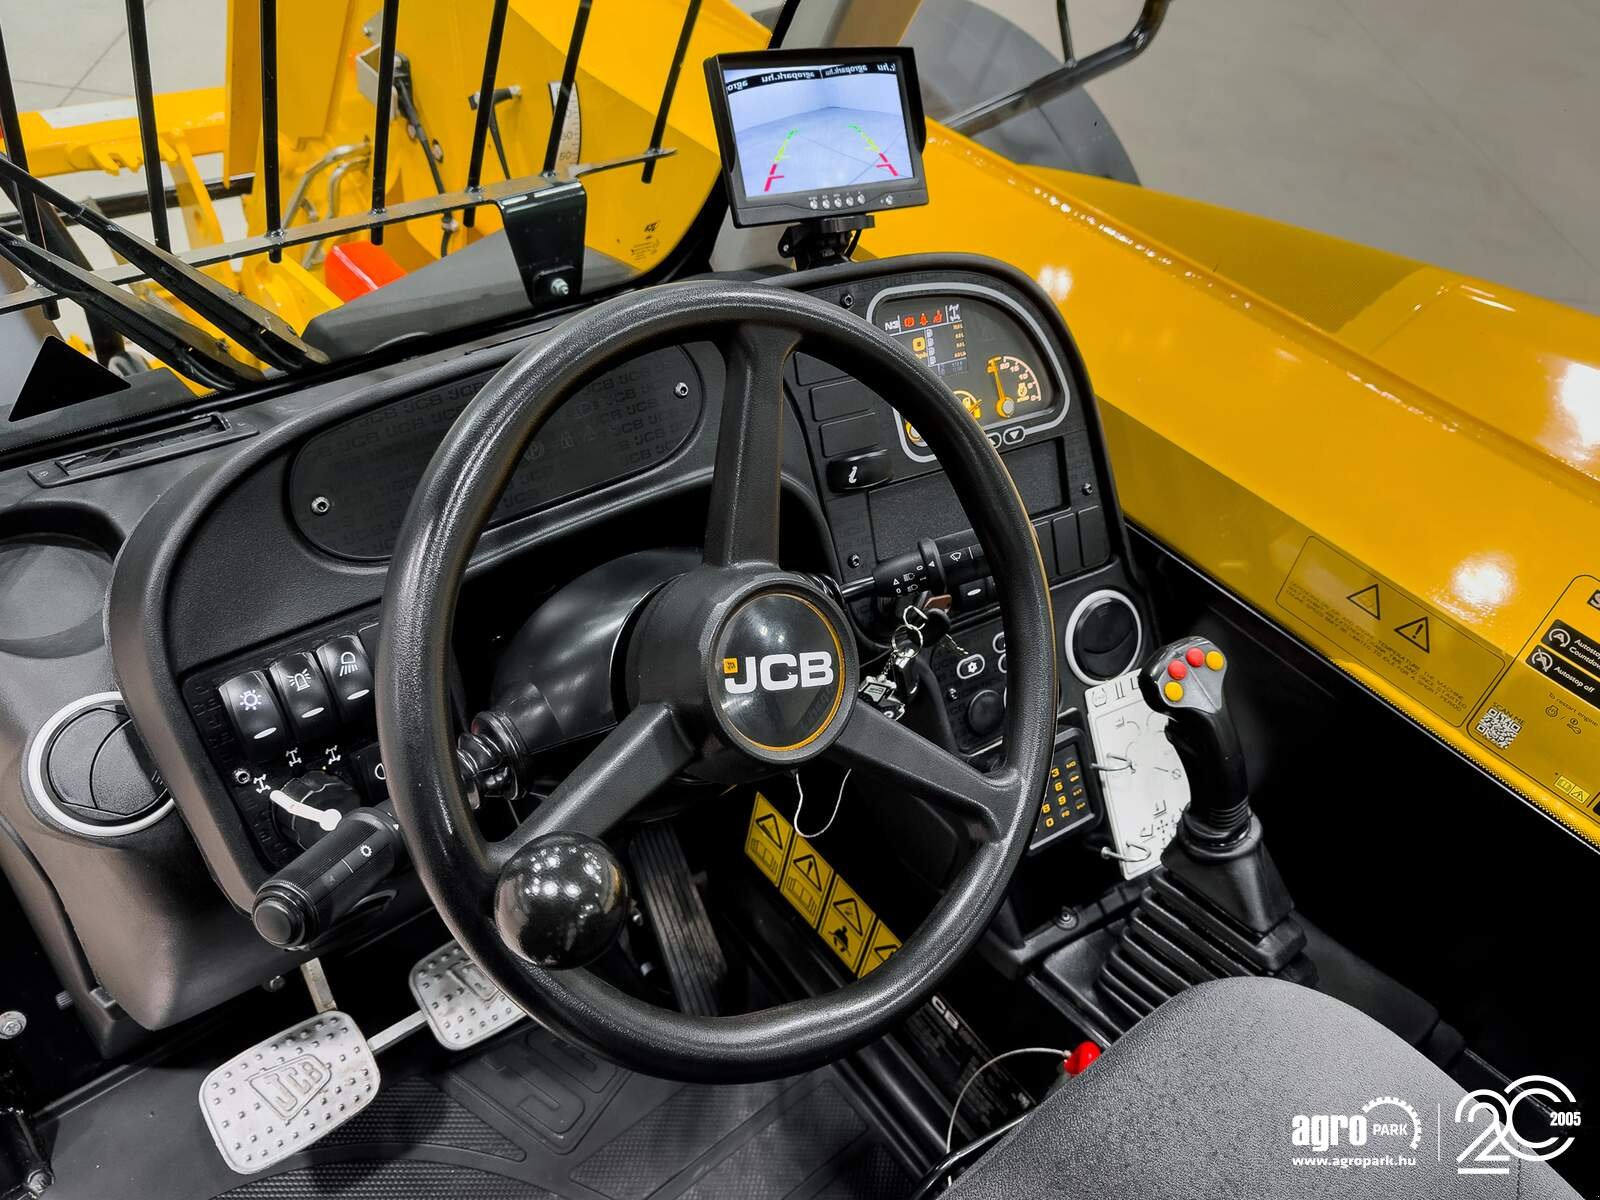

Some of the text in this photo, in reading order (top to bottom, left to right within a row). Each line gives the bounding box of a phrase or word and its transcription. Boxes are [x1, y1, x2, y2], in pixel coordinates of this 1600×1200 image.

[723, 651, 834, 694] JCB
[1554, 666, 1584, 687] Autostop
[1492, 702, 1525, 726] SCAN ME
[1556, 698, 1576, 712] restart
[1578, 712, 1598, 727] engine
[1052, 768, 1060, 778] 3
[1054, 782, 1063, 792] 6
[1058, 796, 1066, 806] 9
[1046, 817, 1054, 827] 0
[931, 995, 959, 1030] CB
[264, 1061, 322, 1112] JCB
